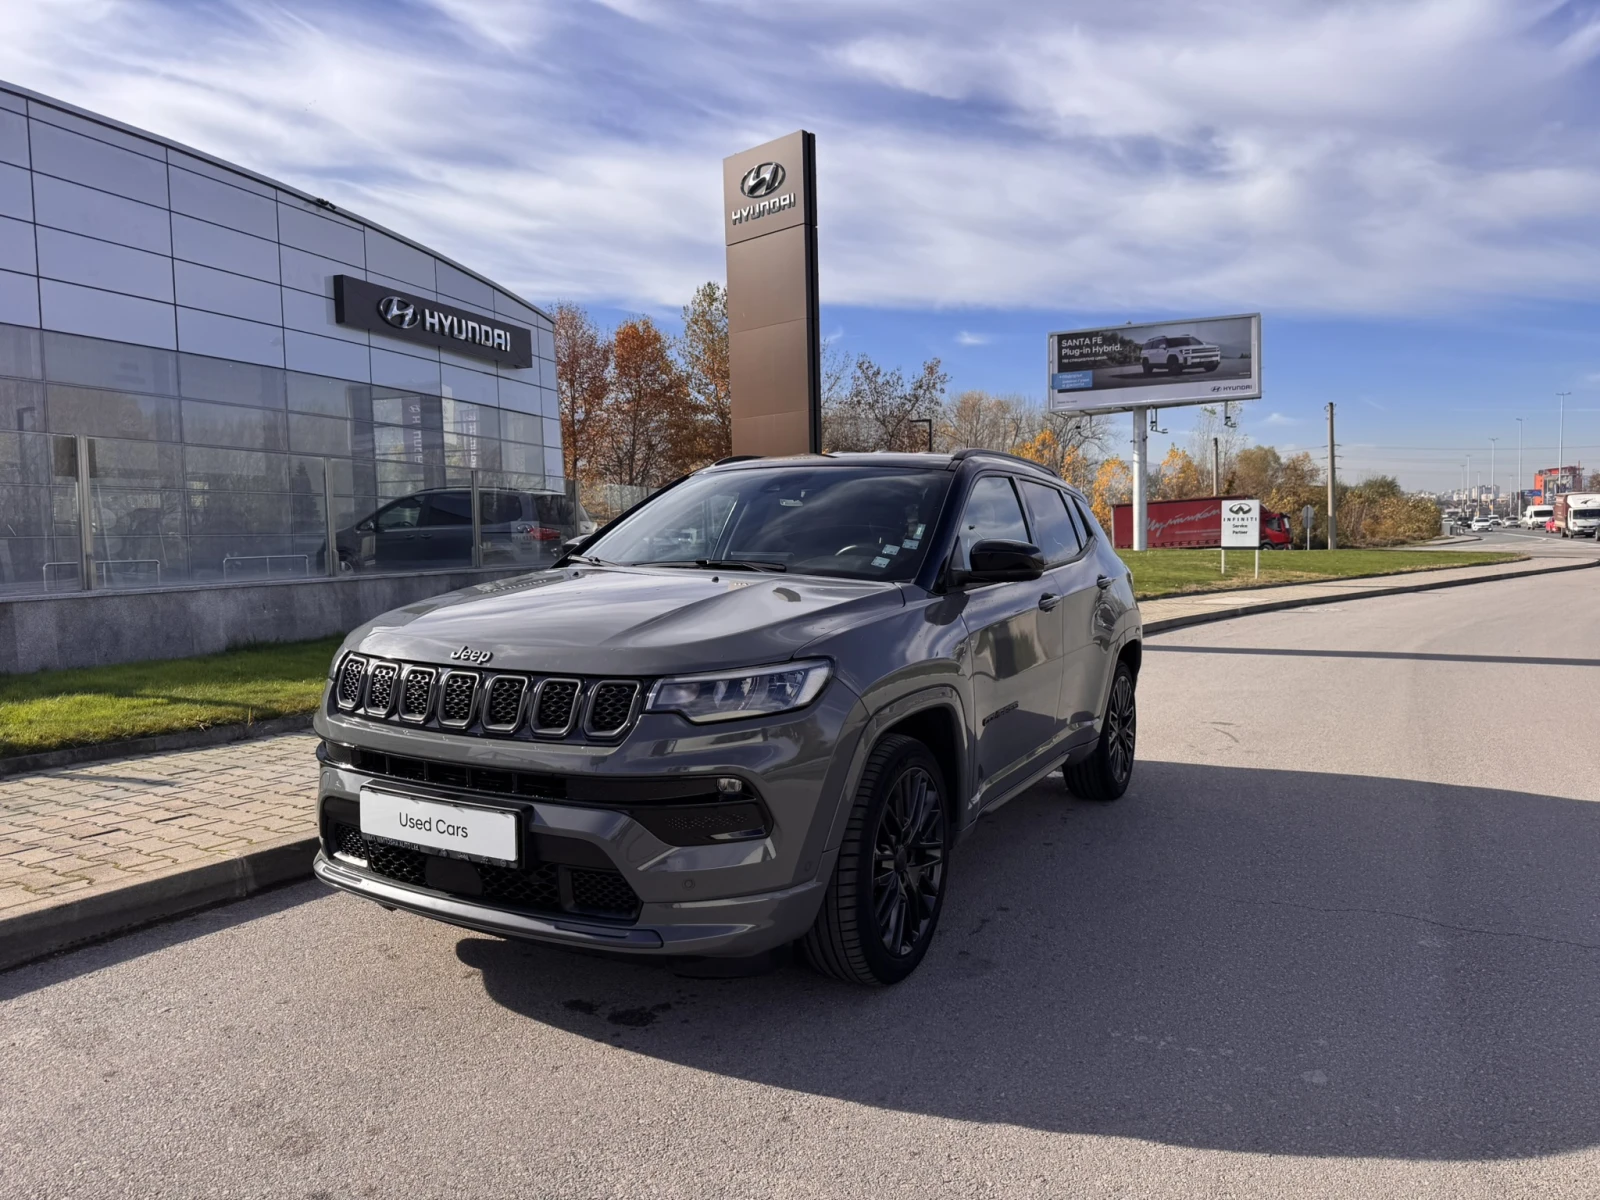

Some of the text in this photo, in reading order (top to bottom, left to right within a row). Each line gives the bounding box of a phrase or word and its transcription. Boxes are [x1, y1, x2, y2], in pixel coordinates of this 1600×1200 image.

[731, 193, 795, 225] HYUNDAI
[424, 308, 510, 352] HYUNDAI
[1061, 336, 1103, 347] SANTA FE
[1061, 343, 1122, 356] Plug-in Hybrid.
[450, 645, 493, 665] Jeep
[399, 812, 468, 838] Used Cars
